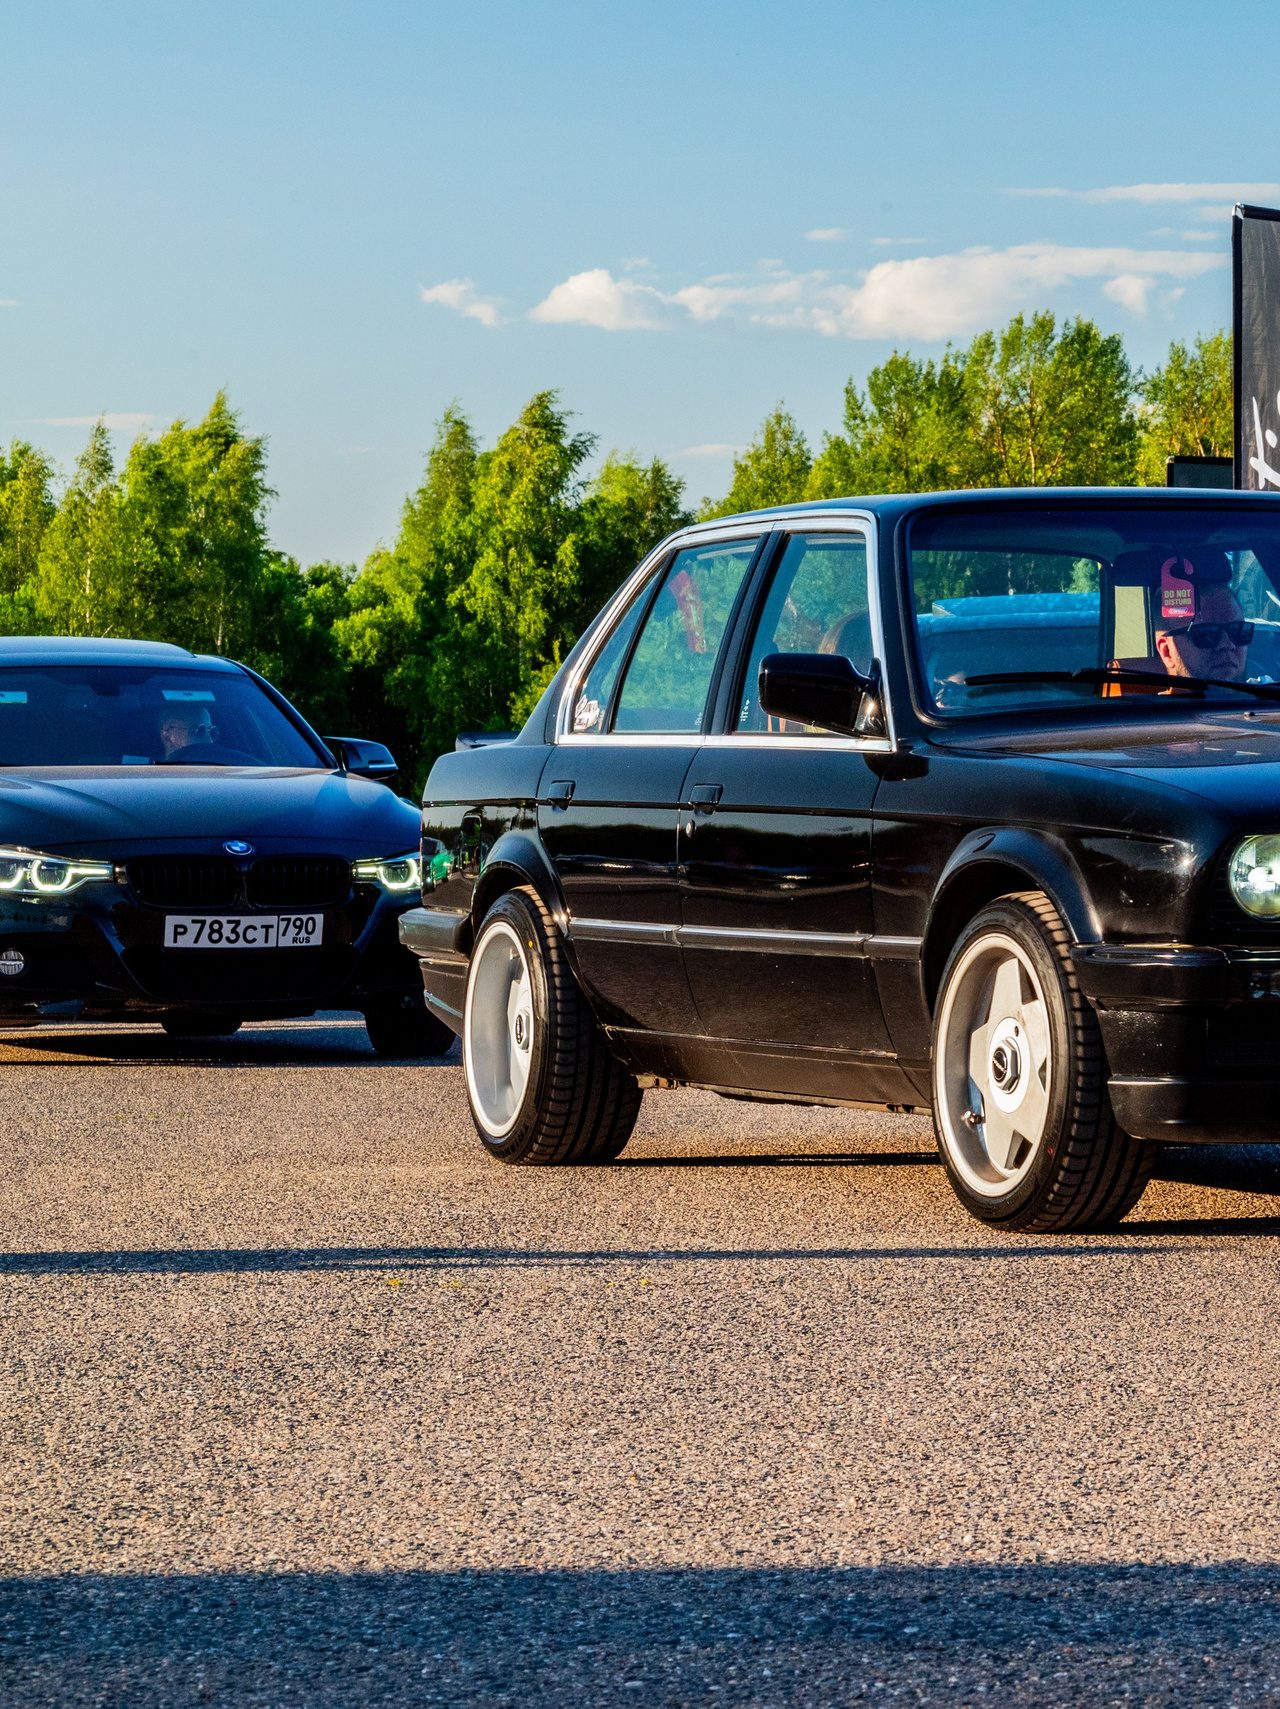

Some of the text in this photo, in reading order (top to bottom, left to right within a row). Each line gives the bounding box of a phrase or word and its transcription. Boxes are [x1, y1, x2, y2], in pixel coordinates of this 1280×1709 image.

[1164, 589, 1192, 599] DO NOT
[1164, 598, 1192, 606] DISTURB
[173, 917, 316, 944] Р783СТ 790
[291, 936, 311, 944] RUS
